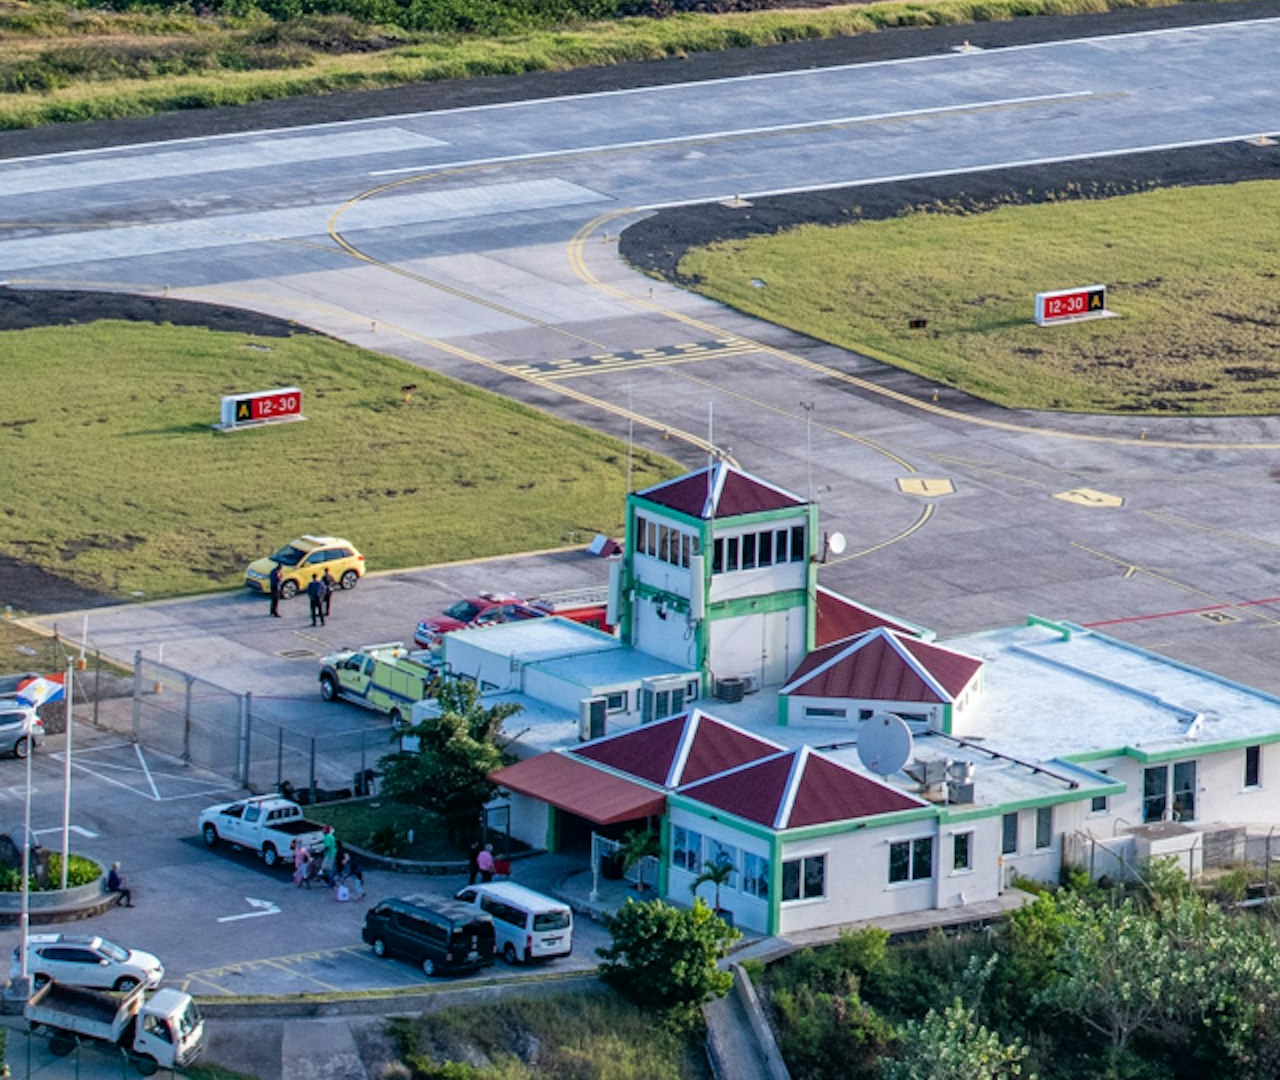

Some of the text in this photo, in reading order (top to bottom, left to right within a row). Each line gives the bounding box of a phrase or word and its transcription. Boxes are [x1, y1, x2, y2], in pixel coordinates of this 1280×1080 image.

[1048, 295, 1101, 313] 12-30 A
[238, 397, 297, 418] A 12-30
